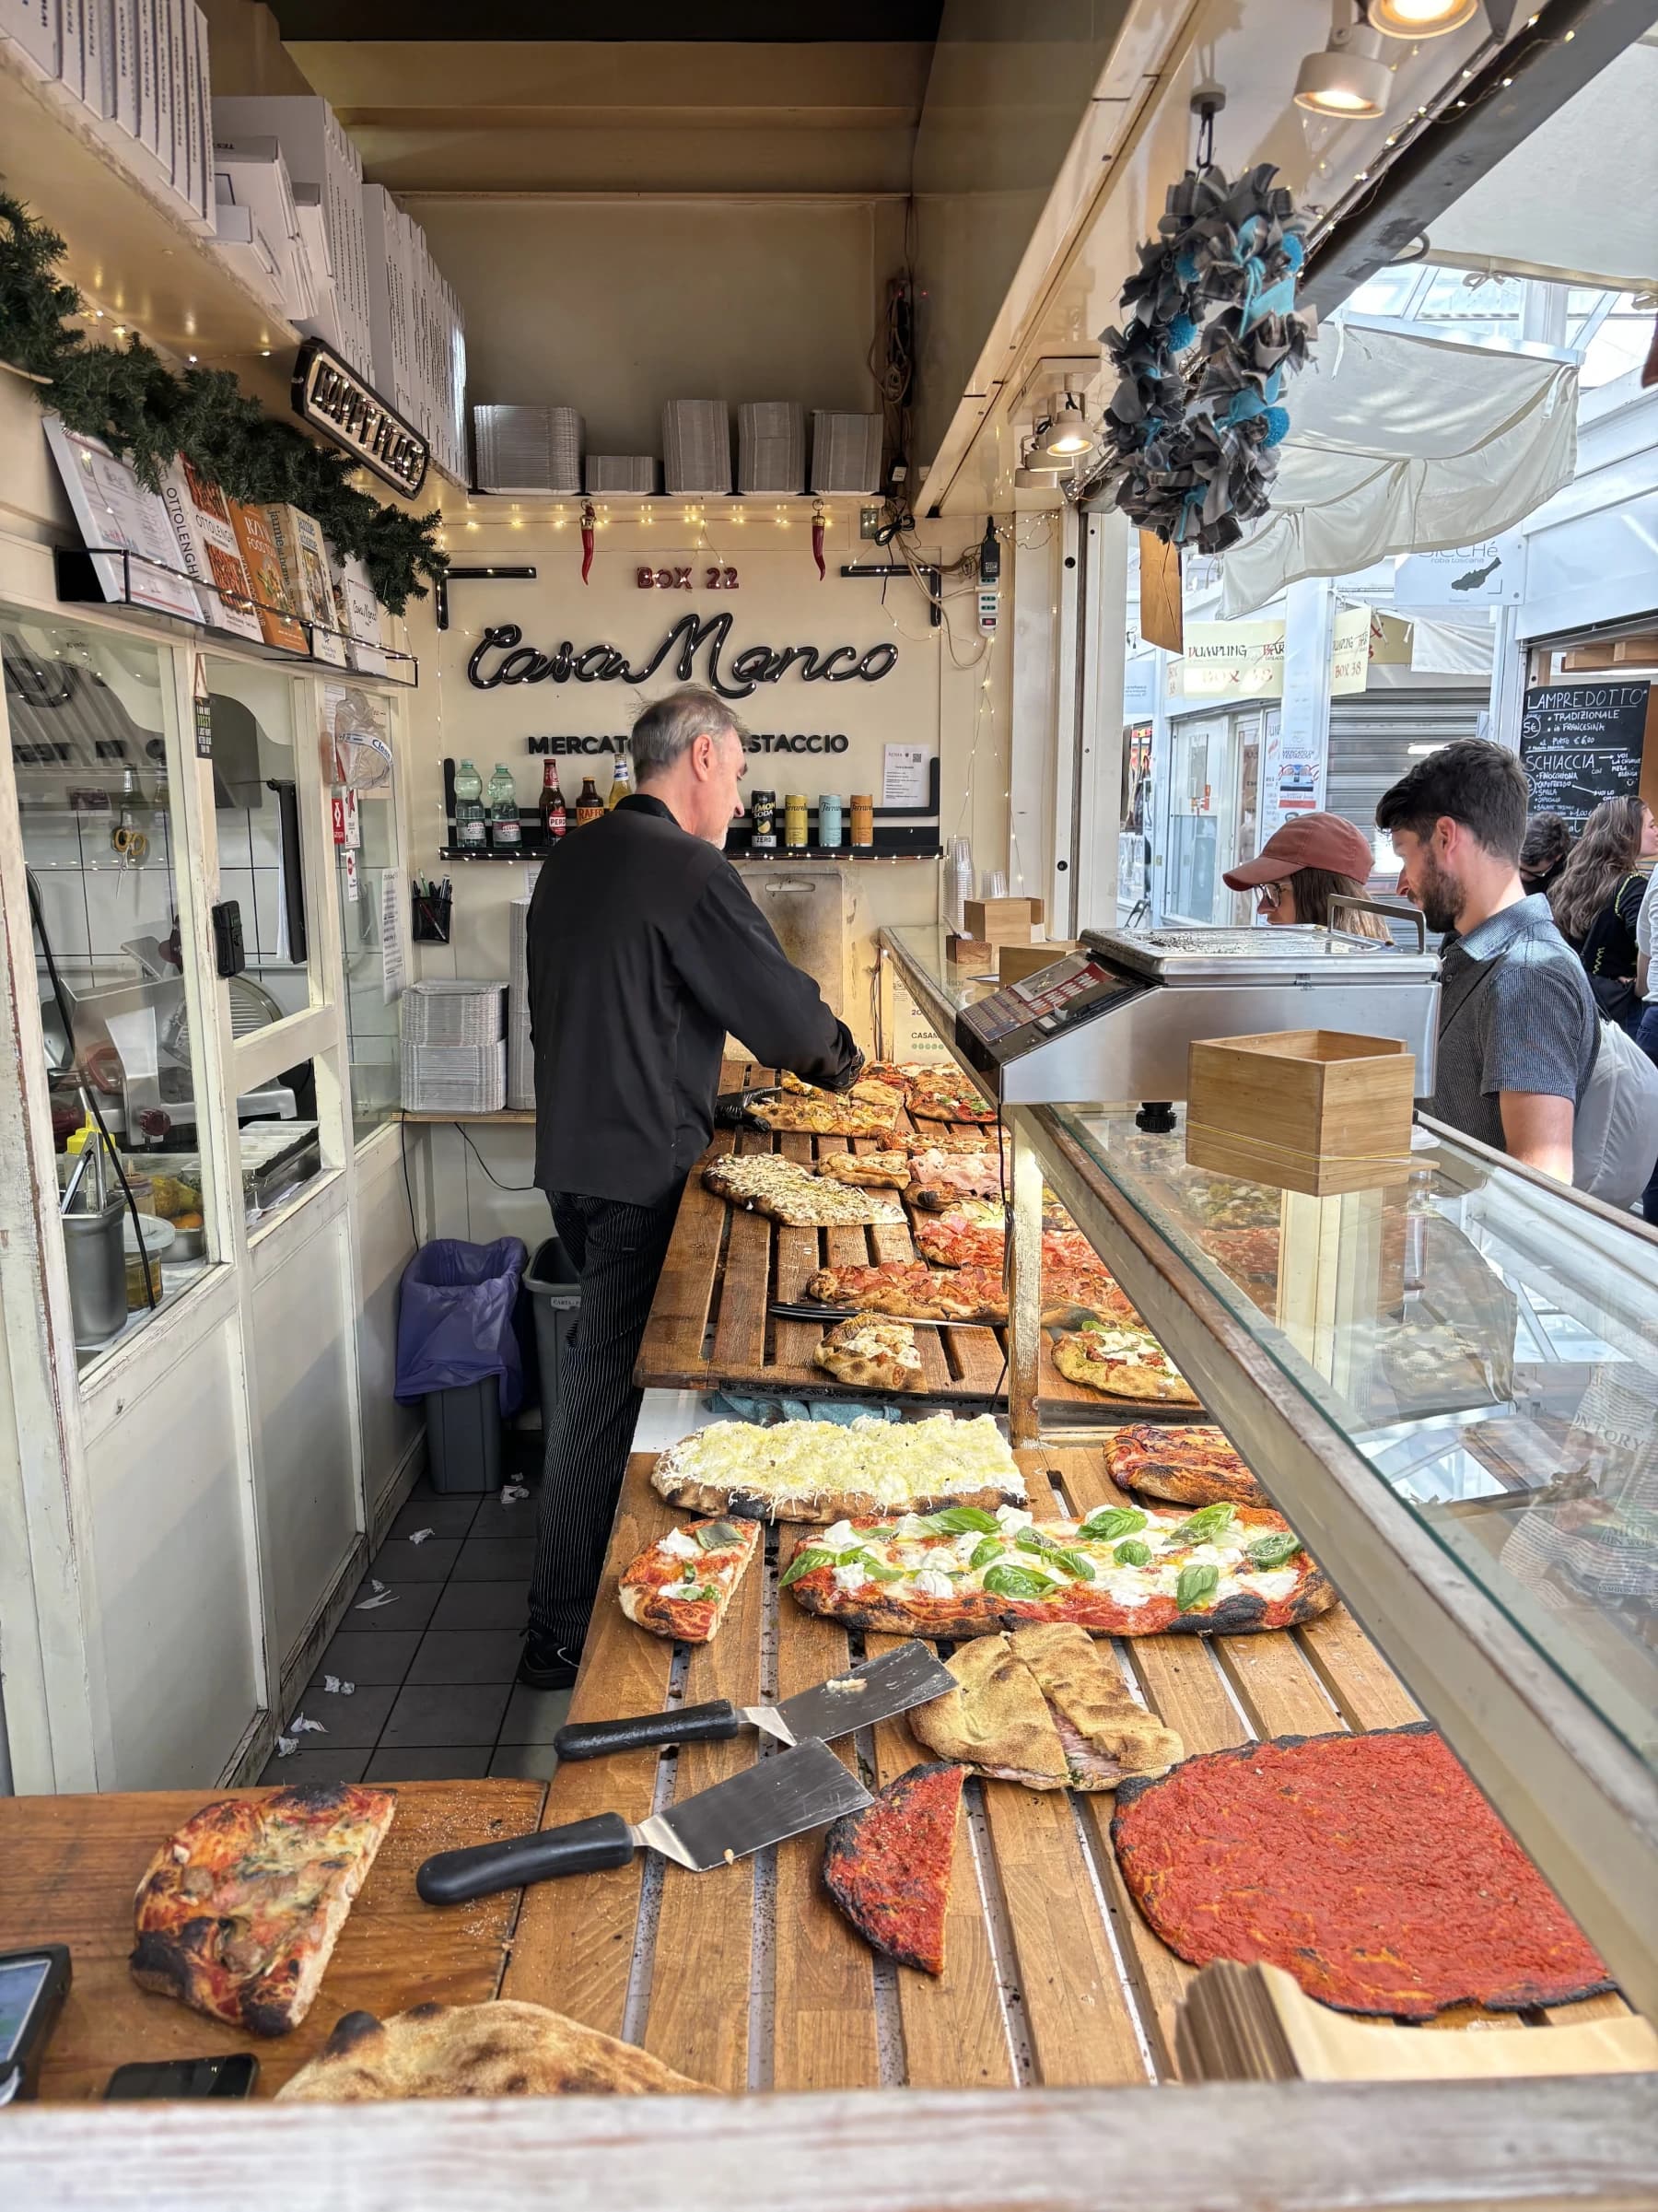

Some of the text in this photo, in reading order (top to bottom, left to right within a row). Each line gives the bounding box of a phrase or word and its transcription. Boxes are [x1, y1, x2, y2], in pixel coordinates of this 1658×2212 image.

[166, 487, 201, 579] OTTOLENGHI
[266, 509, 285, 546] jamie
[706, 567, 740, 590] 22
[467, 612, 899, 699] Casa Manco
[1188, 645, 1247, 658] DUMPLING
[1553, 708, 1621, 722] TRADIZIONALE
[741, 734, 849, 755] STACCIO
[1524, 754, 1594, 772] SCHIACCIA
[578, 808, 605, 822] RAFFO
[752, 802, 776, 813] LEMON
[753, 809, 774, 819] SODA
